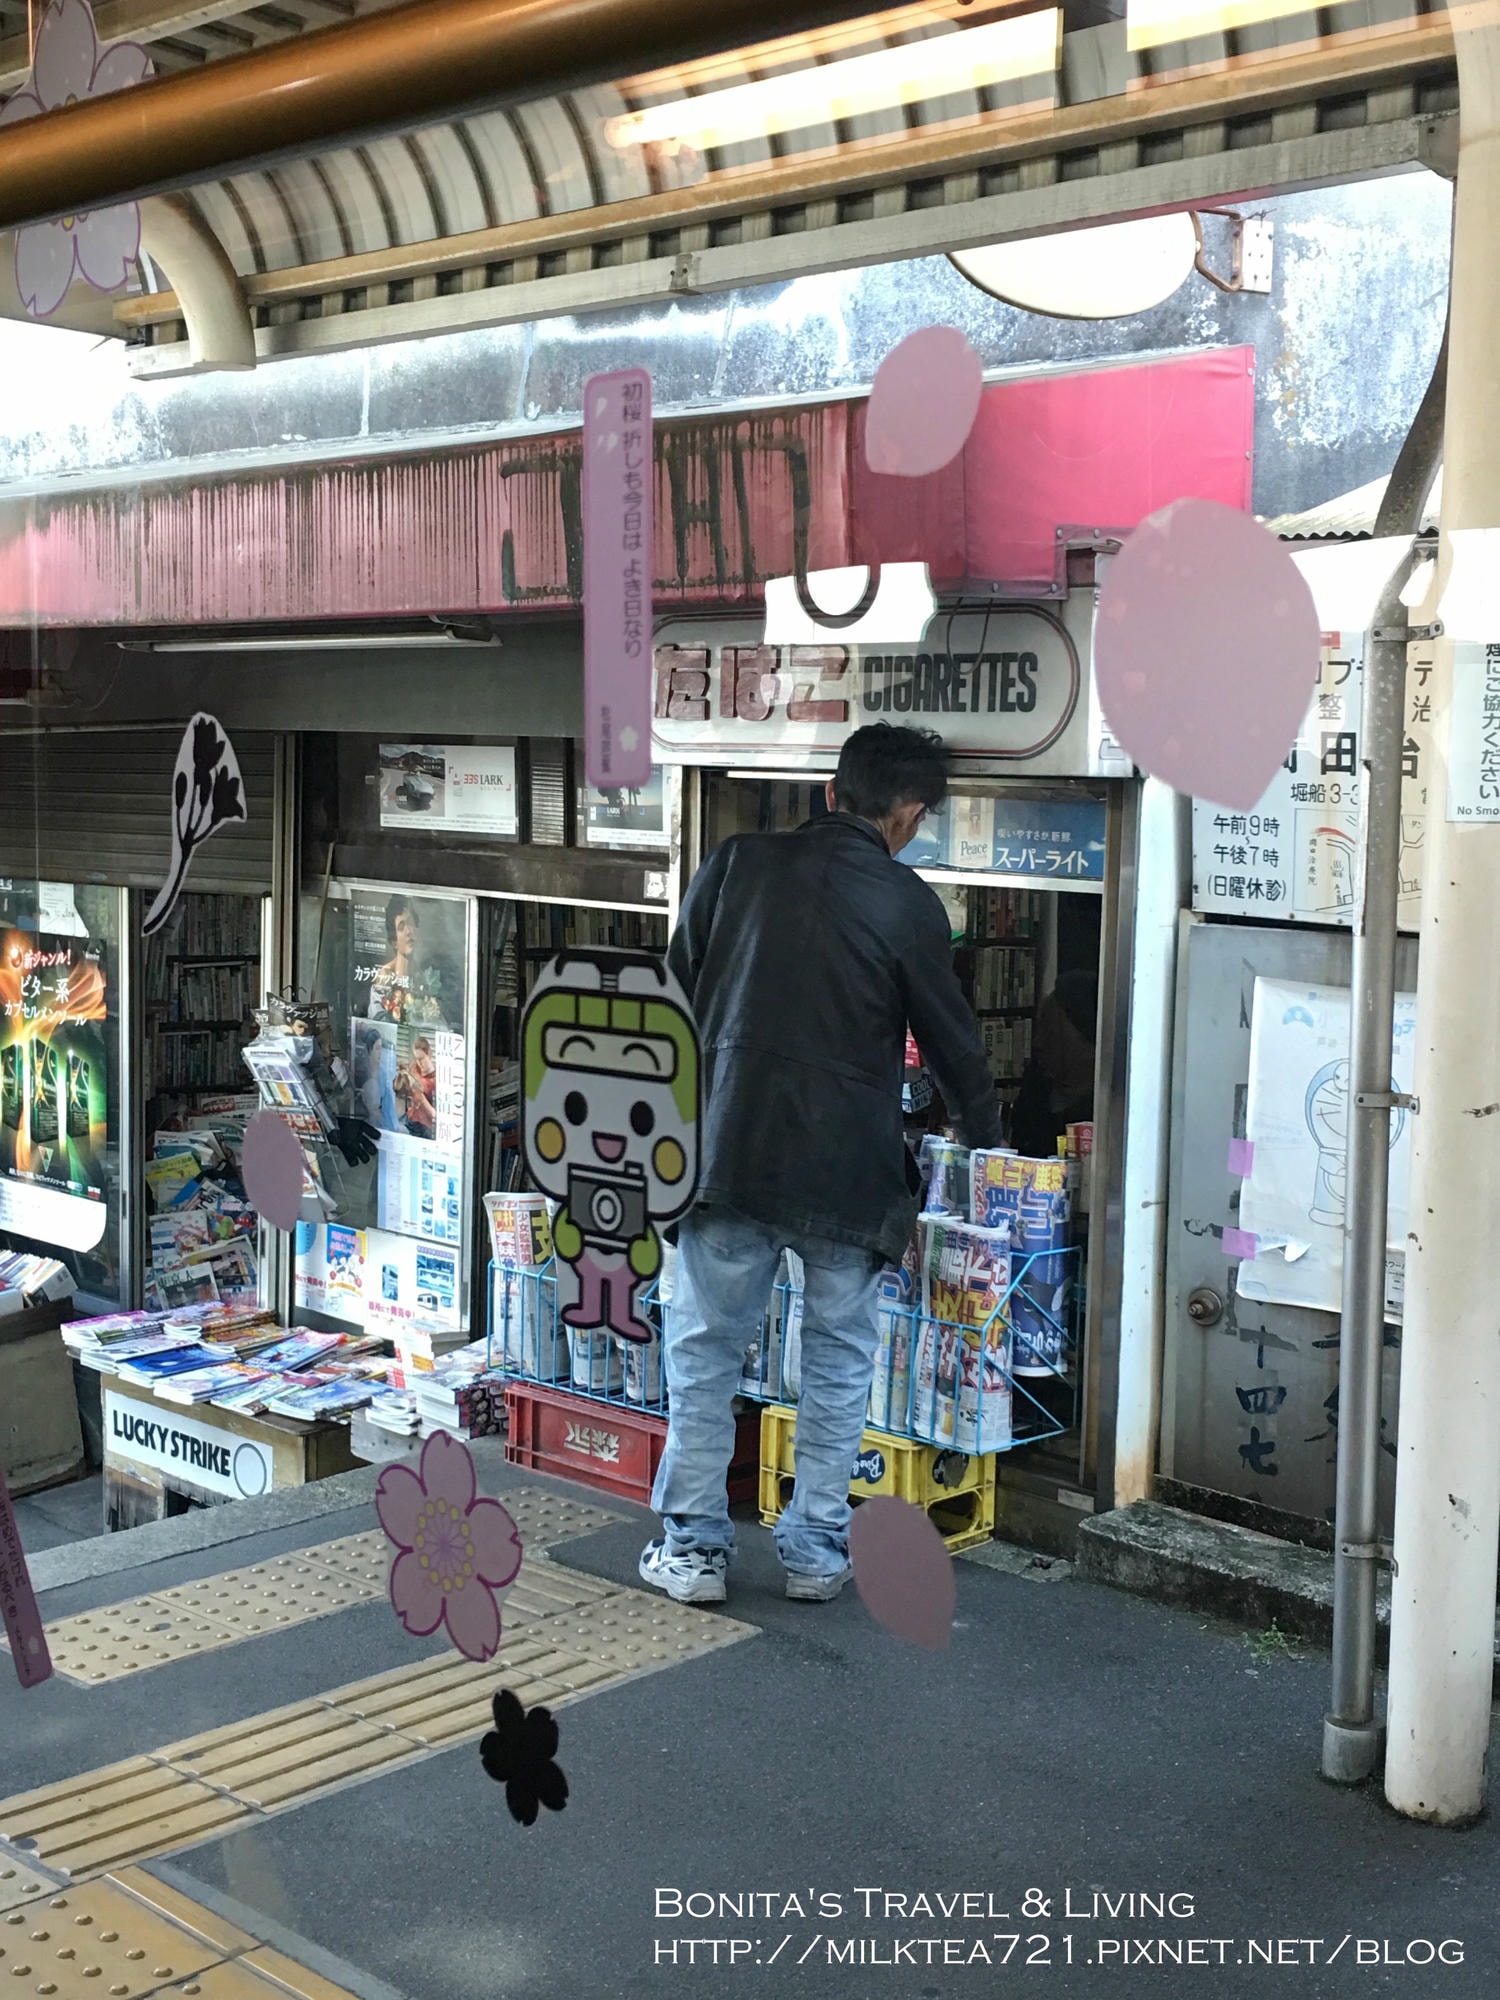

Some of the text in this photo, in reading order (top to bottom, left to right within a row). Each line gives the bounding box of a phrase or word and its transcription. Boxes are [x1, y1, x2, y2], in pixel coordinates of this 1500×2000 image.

[623, 431, 643, 551] 折しも今日は
[623, 558, 643, 659] よき日なり
[655, 643, 850, 723] たばこ
[863, 652, 1039, 714] CIGARETTES
[1213, 813, 1280, 838] 午前9時
[1457, 806, 1472, 816] No
[961, 841, 988, 857] Peace
[994, 847, 1090, 874] スーパーライト
[1213, 843, 1280, 868] 午後7時
[1207, 875, 1287, 902] (日曜休診)
[20, 974, 70, 1003] ビター系
[113, 1409, 232, 1477] LUCKY STRIKE
[563, 1420, 620, 1464] 森永
